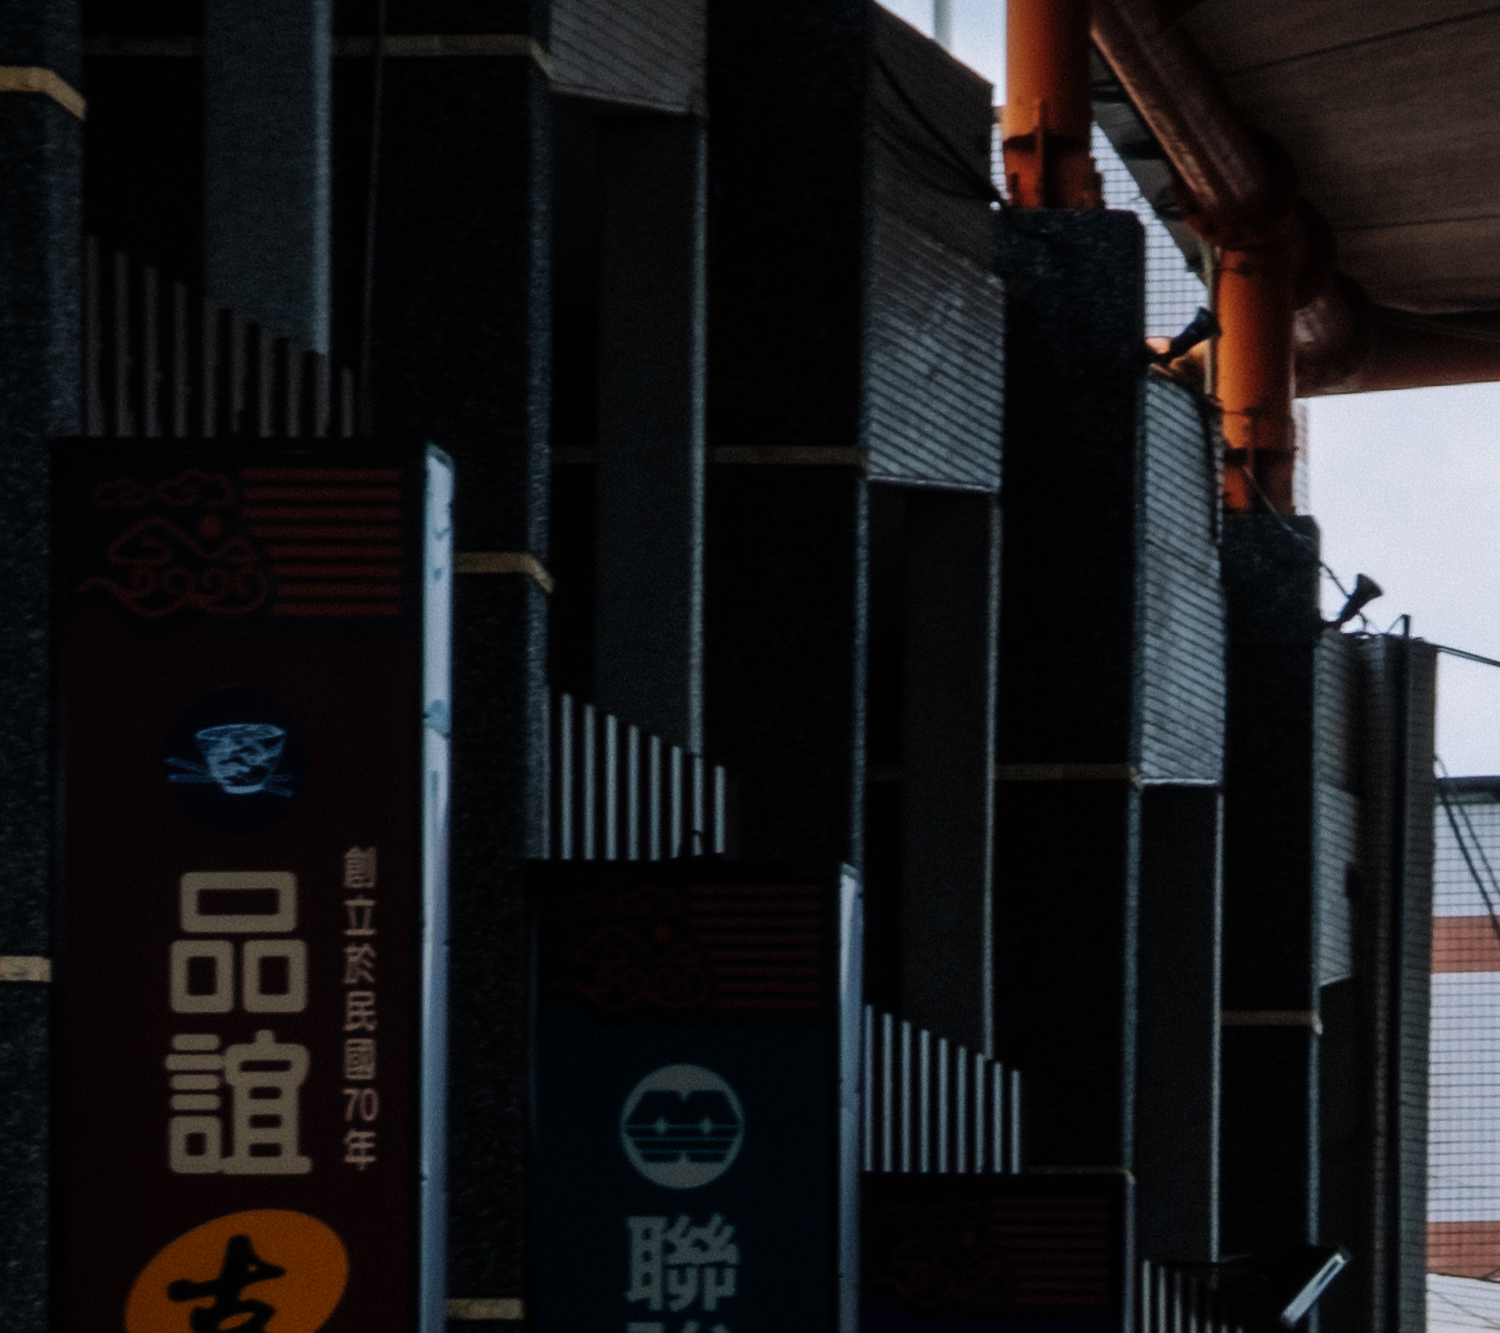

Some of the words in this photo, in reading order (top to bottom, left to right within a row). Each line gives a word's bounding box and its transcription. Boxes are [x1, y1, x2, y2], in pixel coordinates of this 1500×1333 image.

[164, 869, 312, 1177] 品誼
[342, 843, 379, 1172] 創立於民國70年
